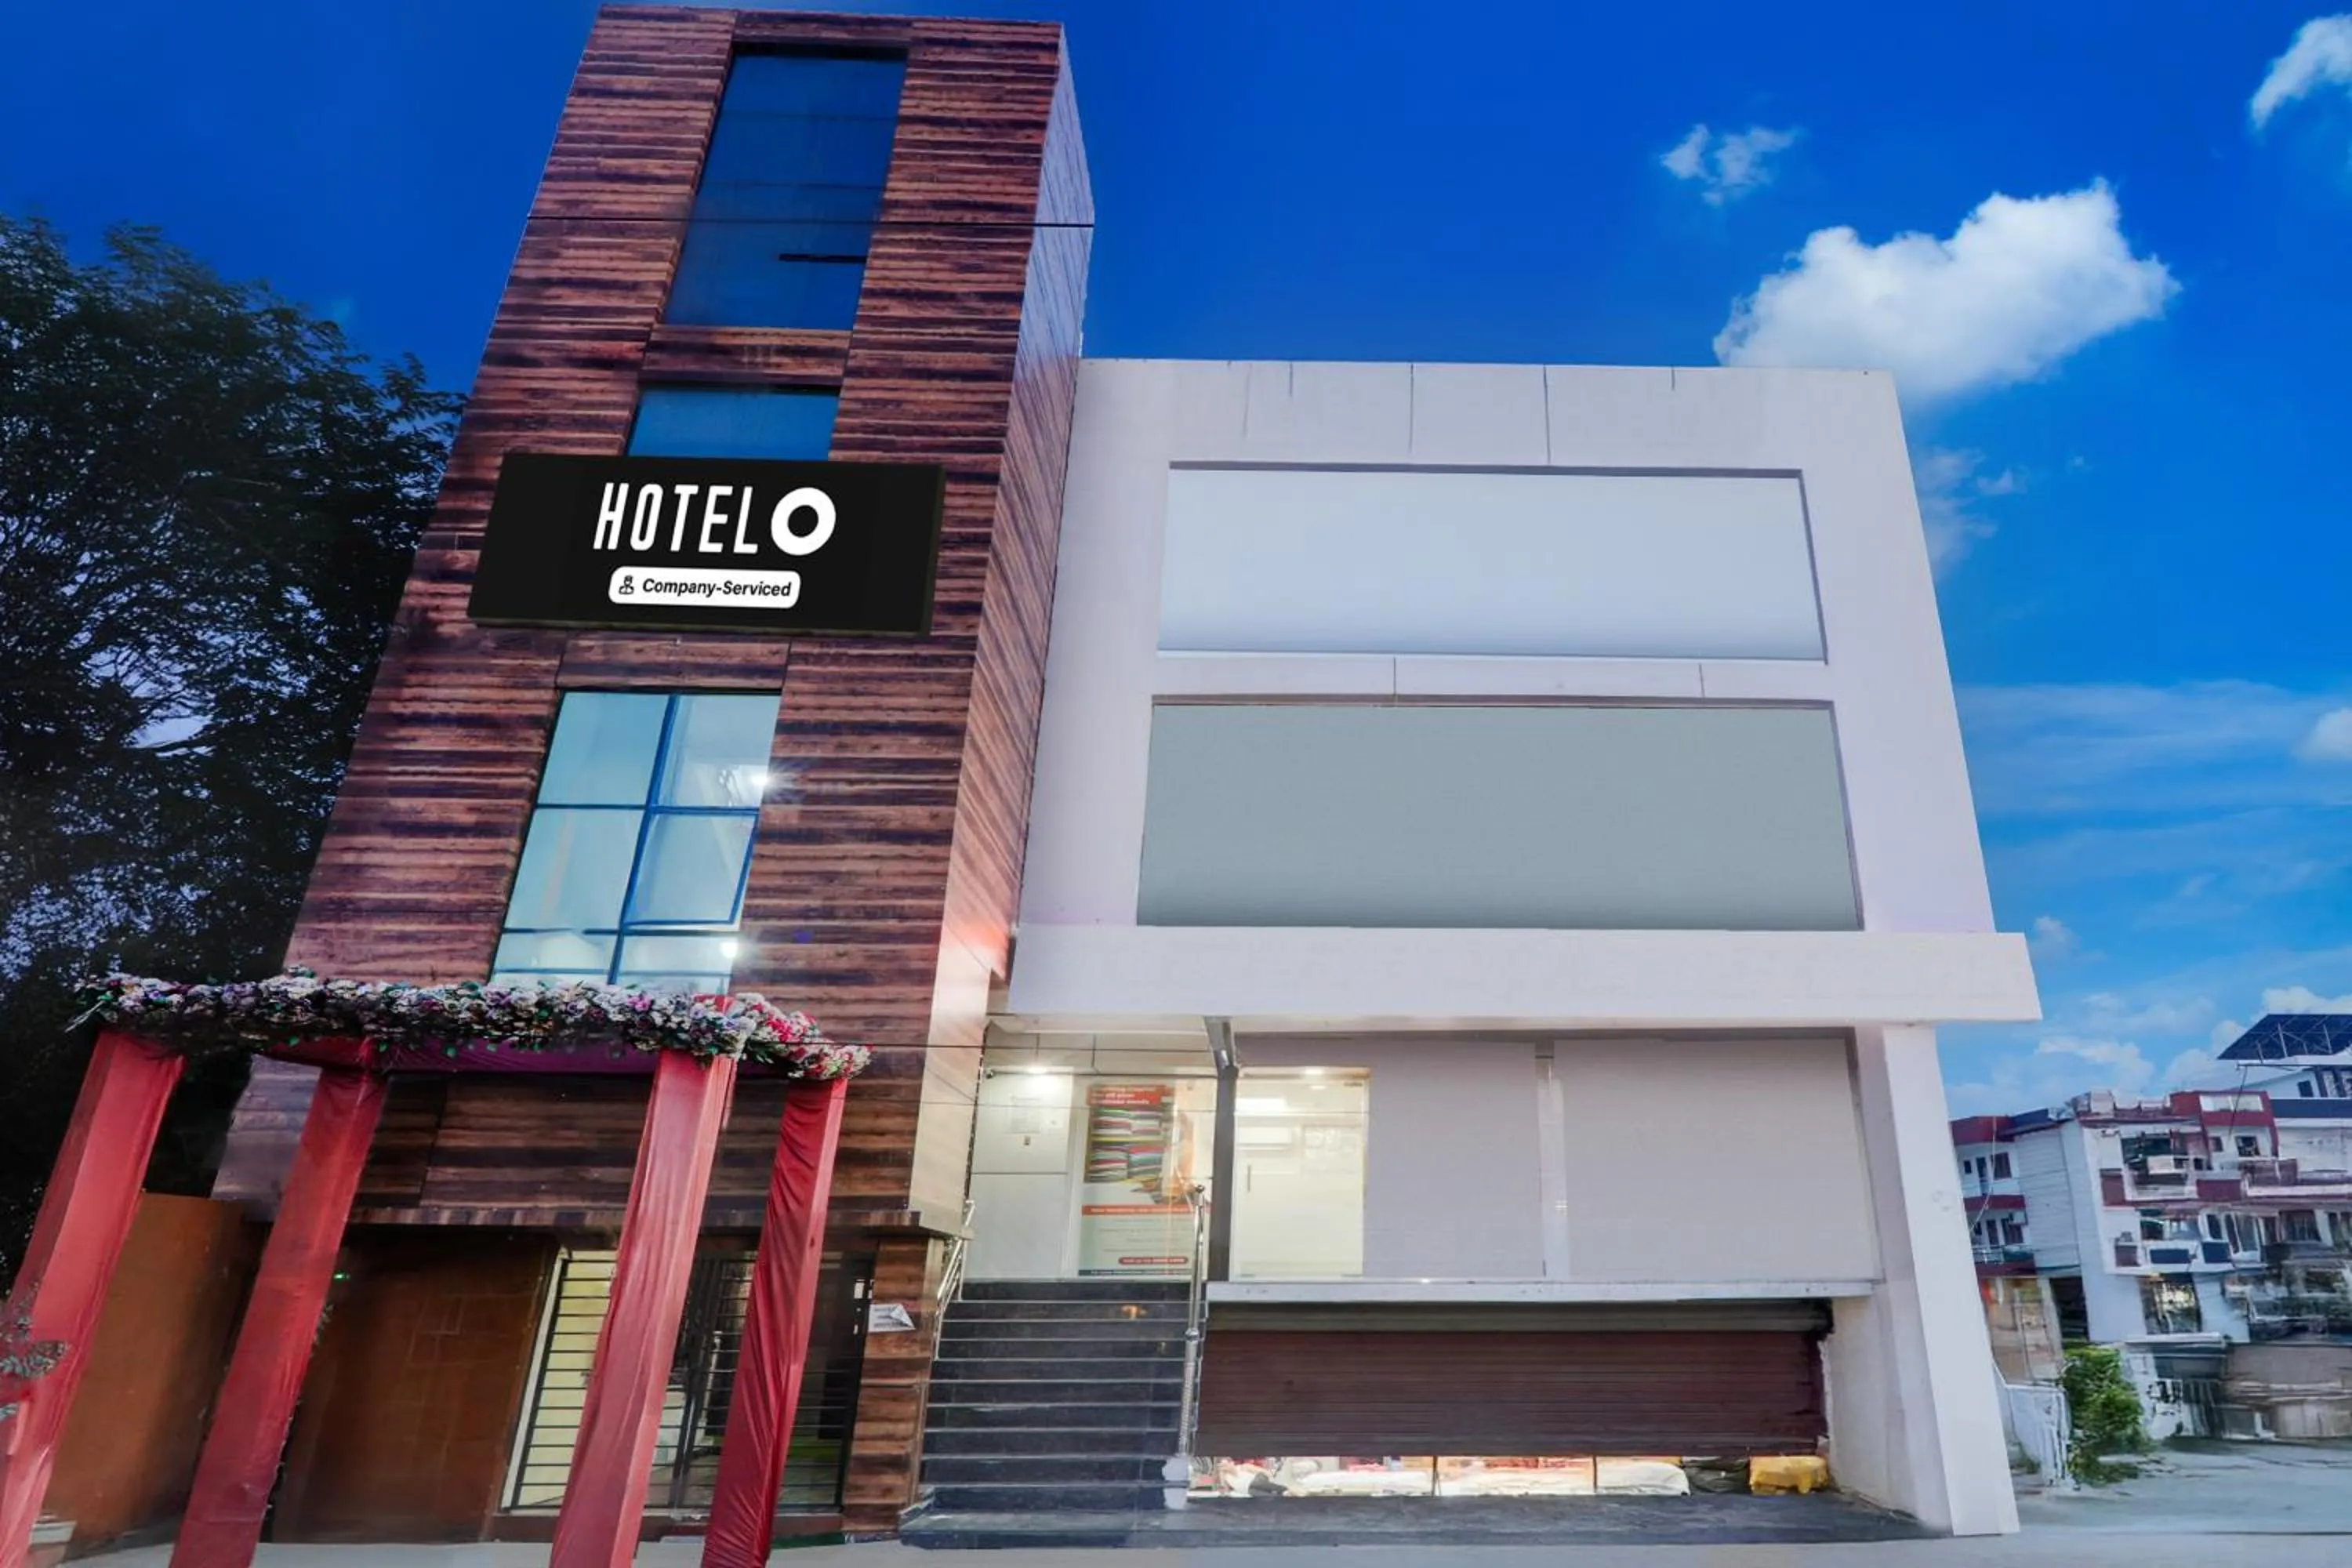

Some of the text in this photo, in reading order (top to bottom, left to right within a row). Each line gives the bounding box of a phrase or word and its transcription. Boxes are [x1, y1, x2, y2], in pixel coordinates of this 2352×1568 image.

[593, 482, 837, 556] HOTEL O
[642, 577, 792, 598] Company-Serviced
